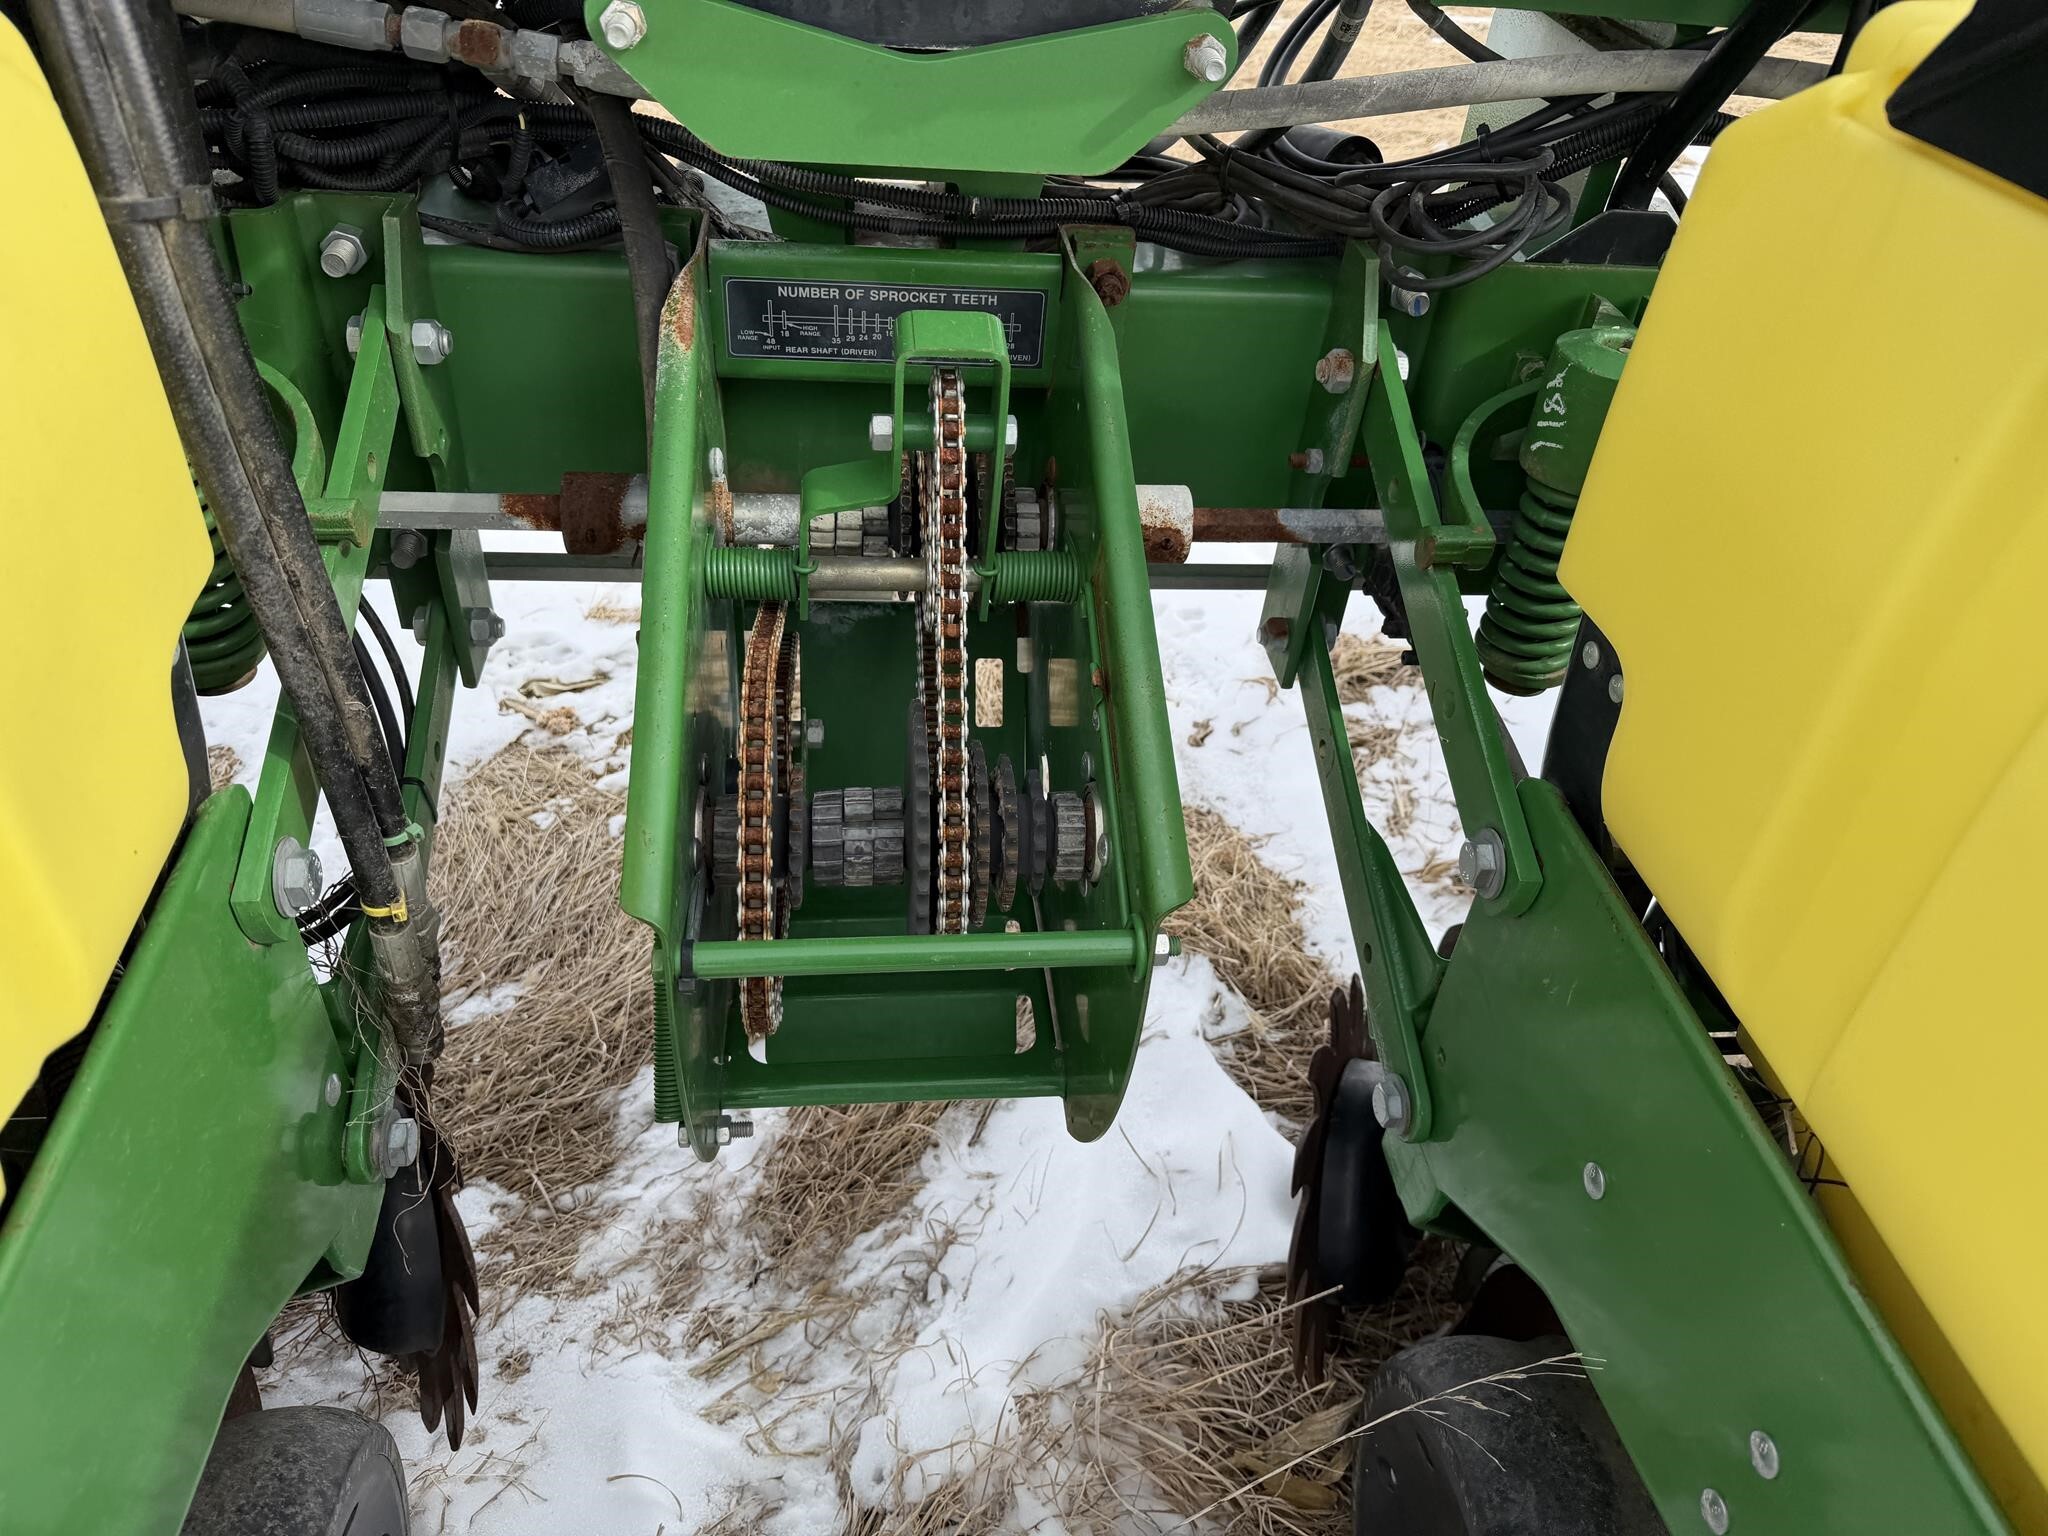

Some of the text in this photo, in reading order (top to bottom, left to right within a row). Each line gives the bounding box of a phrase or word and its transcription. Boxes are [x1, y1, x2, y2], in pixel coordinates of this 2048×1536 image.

[778, 286, 998, 306] NUMBER OF SPROCKET TEETH
[841, 348, 877, 356] (DRIVER)
